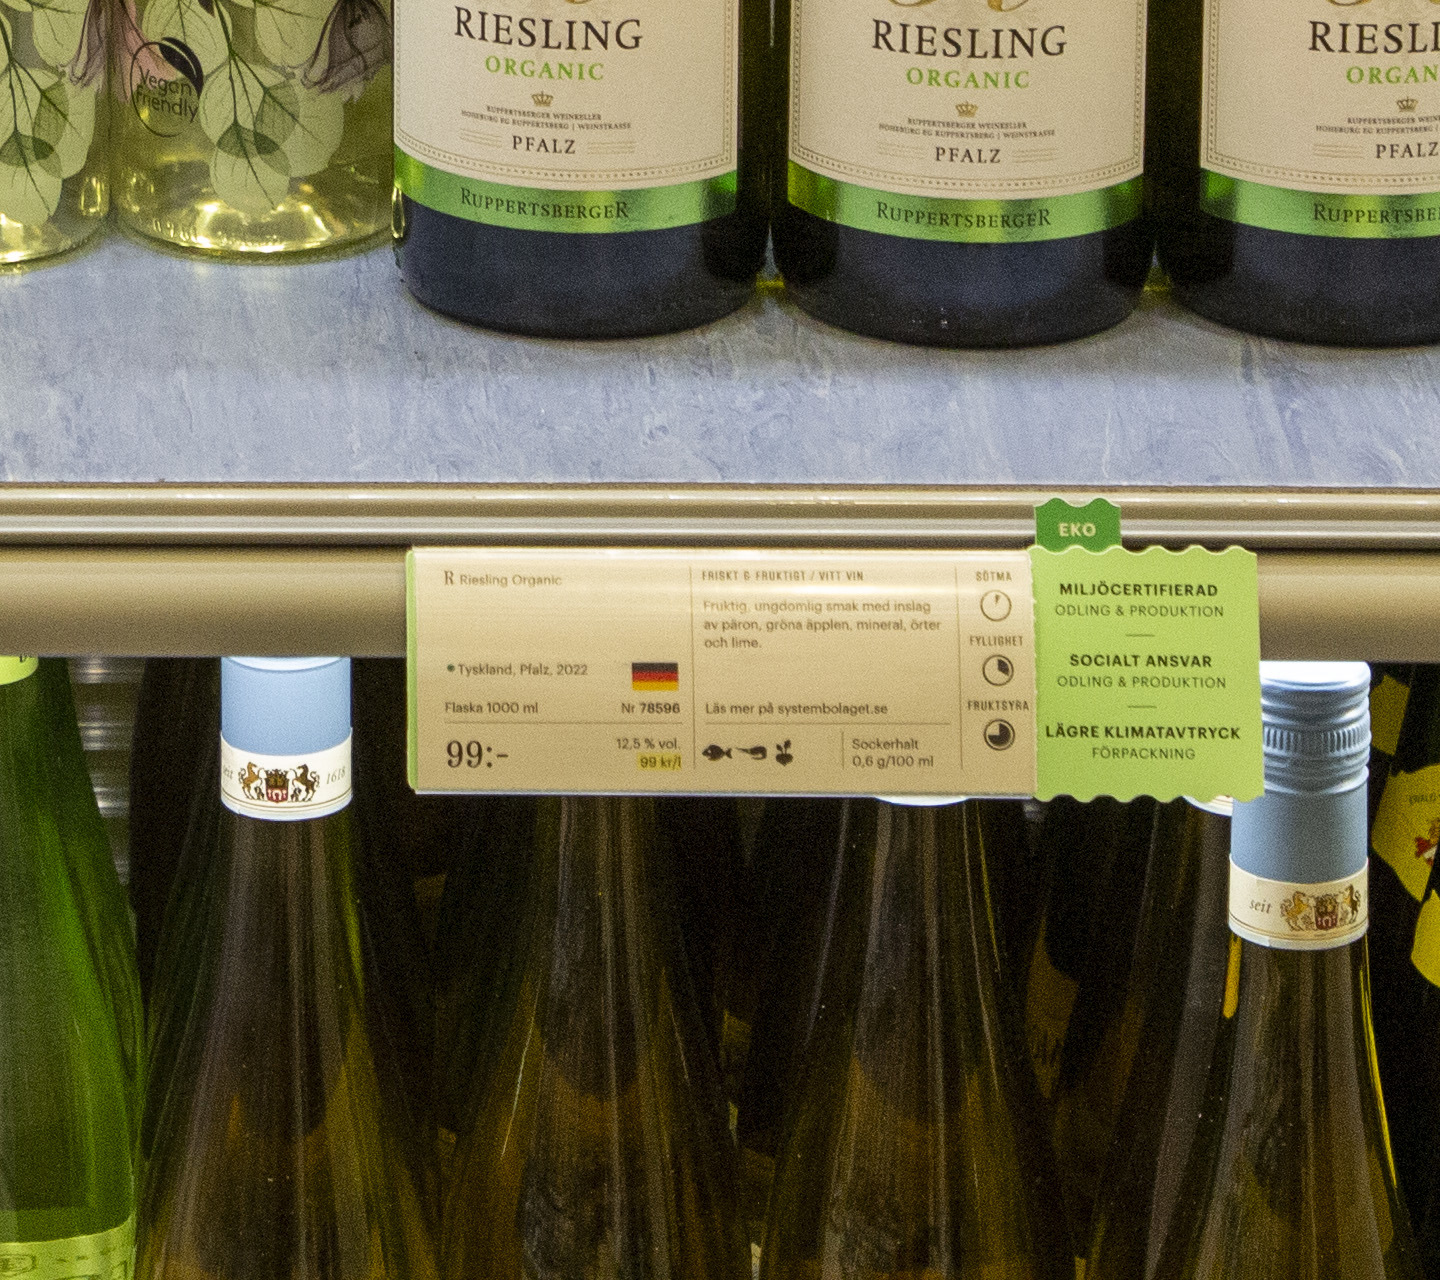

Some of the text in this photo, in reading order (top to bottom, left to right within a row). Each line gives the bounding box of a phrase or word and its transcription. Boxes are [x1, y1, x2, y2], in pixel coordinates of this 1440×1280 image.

[454, 5, 642, 52] RIESLING
[872, 18, 1068, 60] RIESLING
[486, 56, 605, 81] ORGANIC
[906, 65, 1031, 90] ORGANIC
[511, 133, 577, 156] PFALZ
[935, 143, 1002, 165] PFALZ
[1375, 139, 1440, 161] PFALZ
[460, 186, 630, 223] RUPPERTSBERGER
[876, 202, 1052, 231] RUPPERTSBERGER
[1059, 523, 1096, 538] EKO
[443, 570, 562, 589] R Riesling Organic
[1059, 581, 1218, 597] MILJÖCERTIFIERAD
[1054, 604, 1224, 617] ODLING & PRODUKTION
[1069, 654, 1213, 668] SOCIALT ANSVAR
[1057, 676, 1227, 689] ODLING & PRODUKTION
[621, 703, 680, 715] Nr 78596
[1045, 725, 1241, 741] LÄGRE KLIMATAVTRYCK
[1092, 745, 1196, 760] FÖRPACKNING
